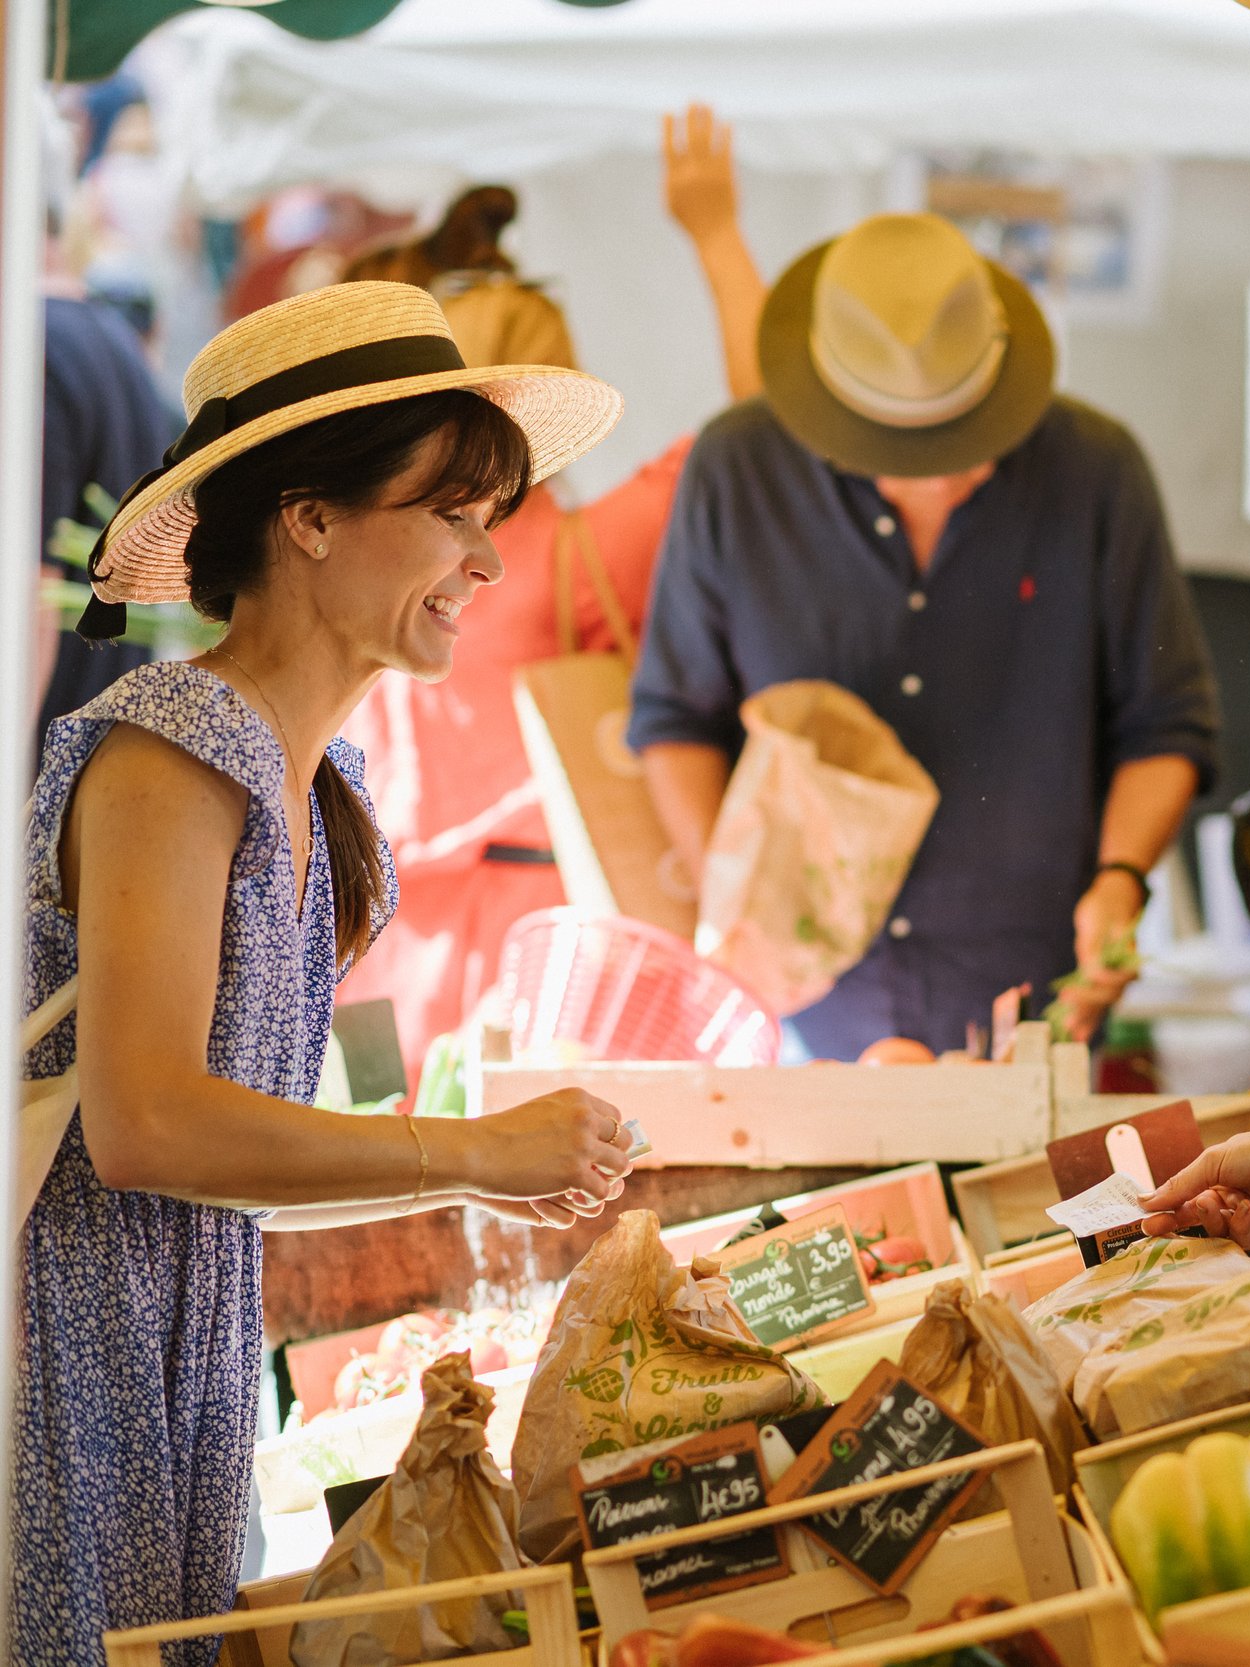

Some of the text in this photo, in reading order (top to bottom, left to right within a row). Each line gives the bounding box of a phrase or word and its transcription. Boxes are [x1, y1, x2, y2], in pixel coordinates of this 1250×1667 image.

[1107, 1224, 1133, 1238] Circuit
[650, 1364, 764, 1396] Fruits
[703, 1392, 724, 1416] &
